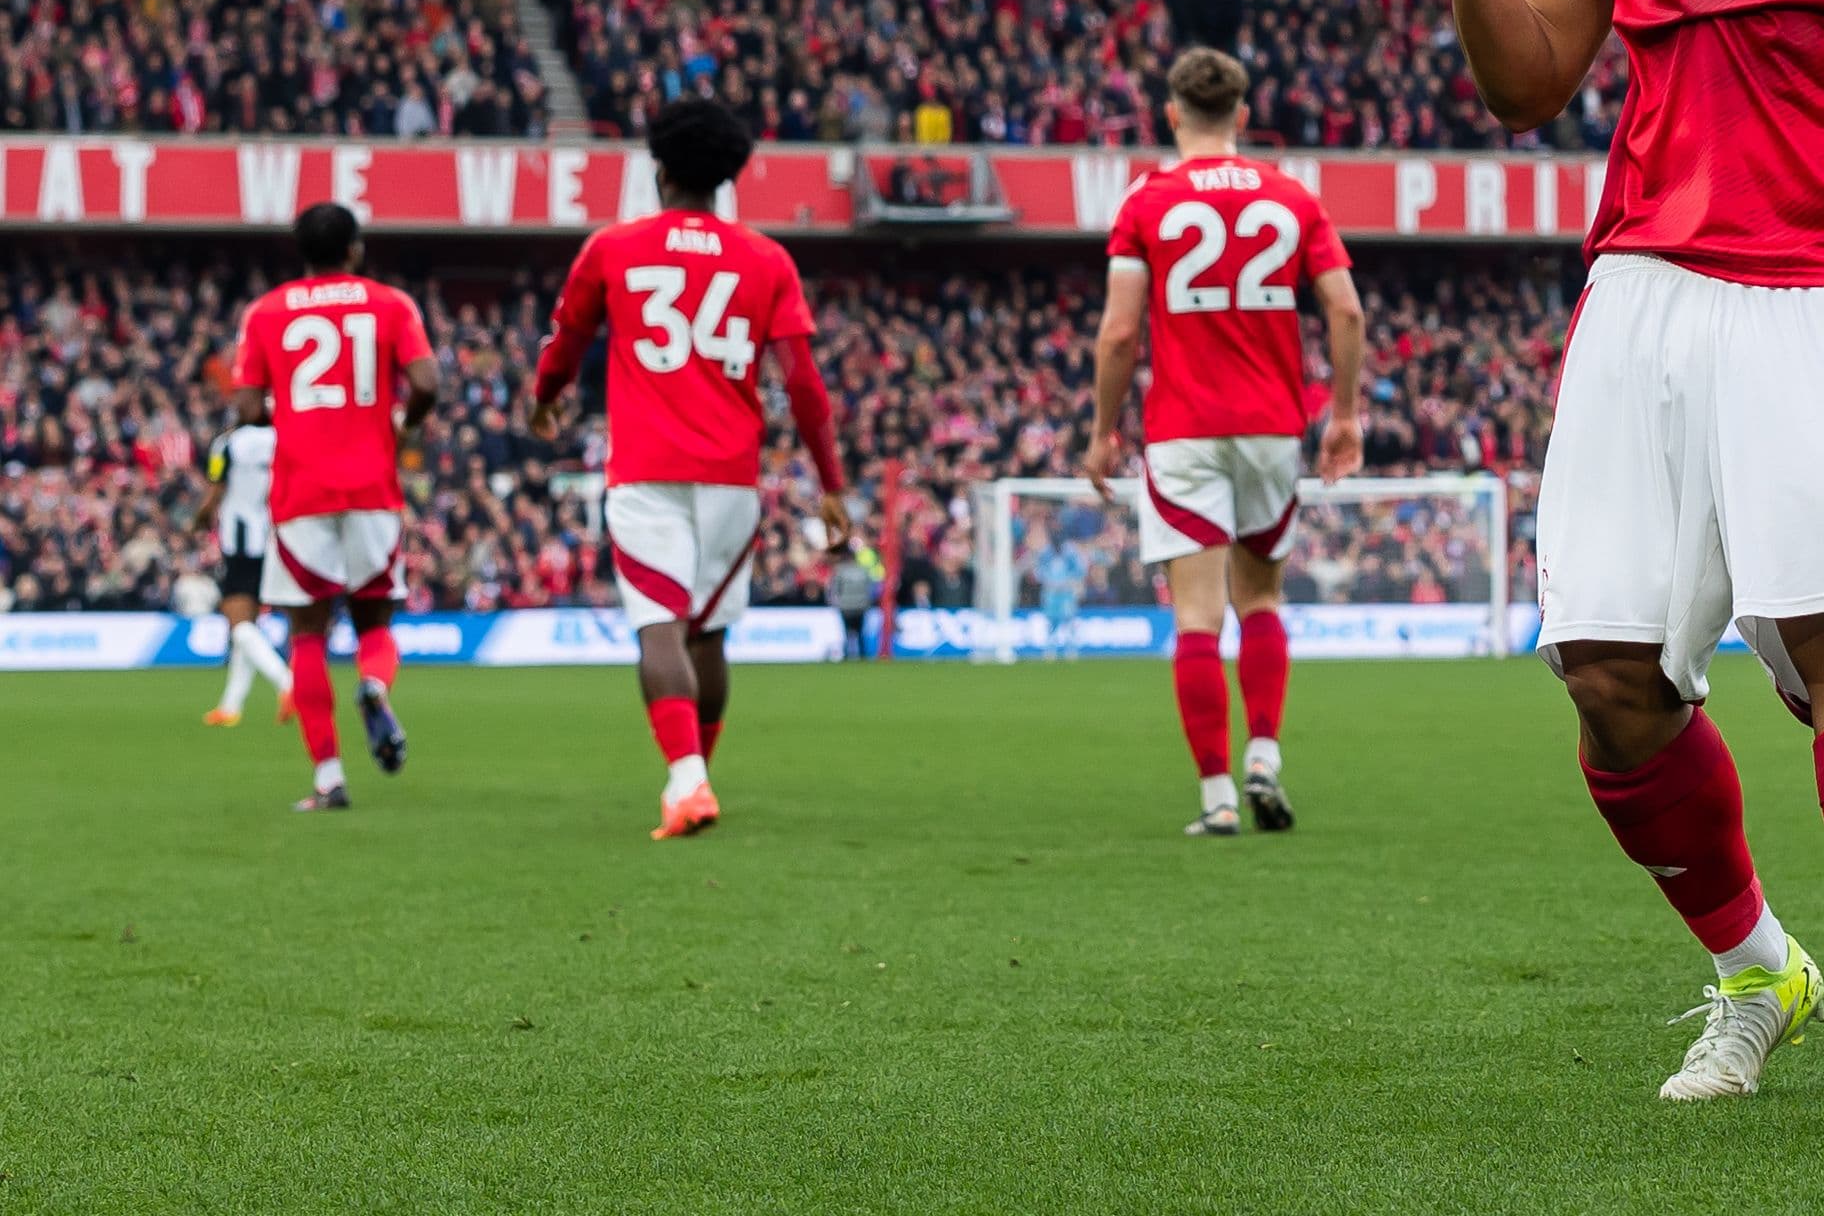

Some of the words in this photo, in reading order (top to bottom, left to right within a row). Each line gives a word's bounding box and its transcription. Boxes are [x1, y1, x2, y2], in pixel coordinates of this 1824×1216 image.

[0, 144, 156, 222] AT
[237, 144, 373, 225] WE
[1188, 166, 1262, 191] YATES
[665, 227, 722, 256] AINA
[1159, 200, 1300, 314] 22
[282, 313, 377, 413] 21
[625, 265, 755, 380] 34
